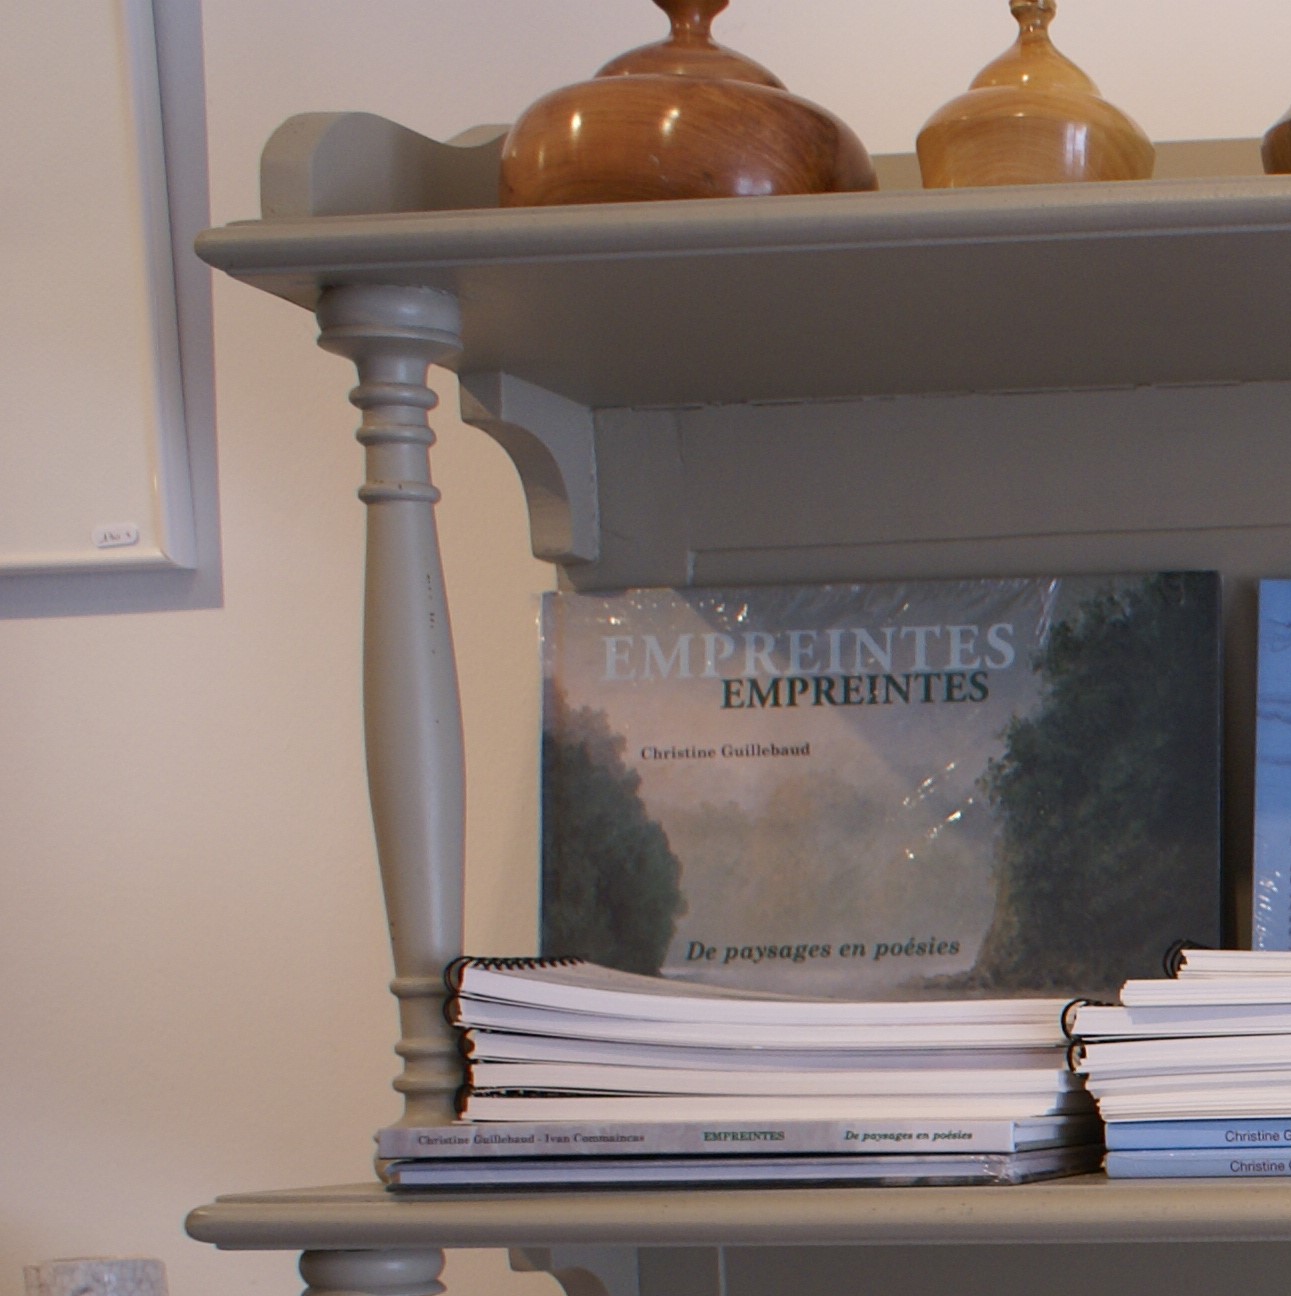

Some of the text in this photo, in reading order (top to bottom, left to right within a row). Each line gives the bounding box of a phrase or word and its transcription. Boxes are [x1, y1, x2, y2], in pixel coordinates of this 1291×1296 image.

[602, 623, 1016, 680] EMPREINTES
[721, 671, 990, 709] EMPREINTES
[641, 743, 810, 760] Christine Guillebaud
[686, 937, 960, 964] De paysages en poésies
[703, 1131, 785, 1143] EMPREINTES
[844, 1130, 859, 1141] De
[1225, 1129, 1280, 1143] Christine
[1230, 1159, 1285, 1173] Christine
